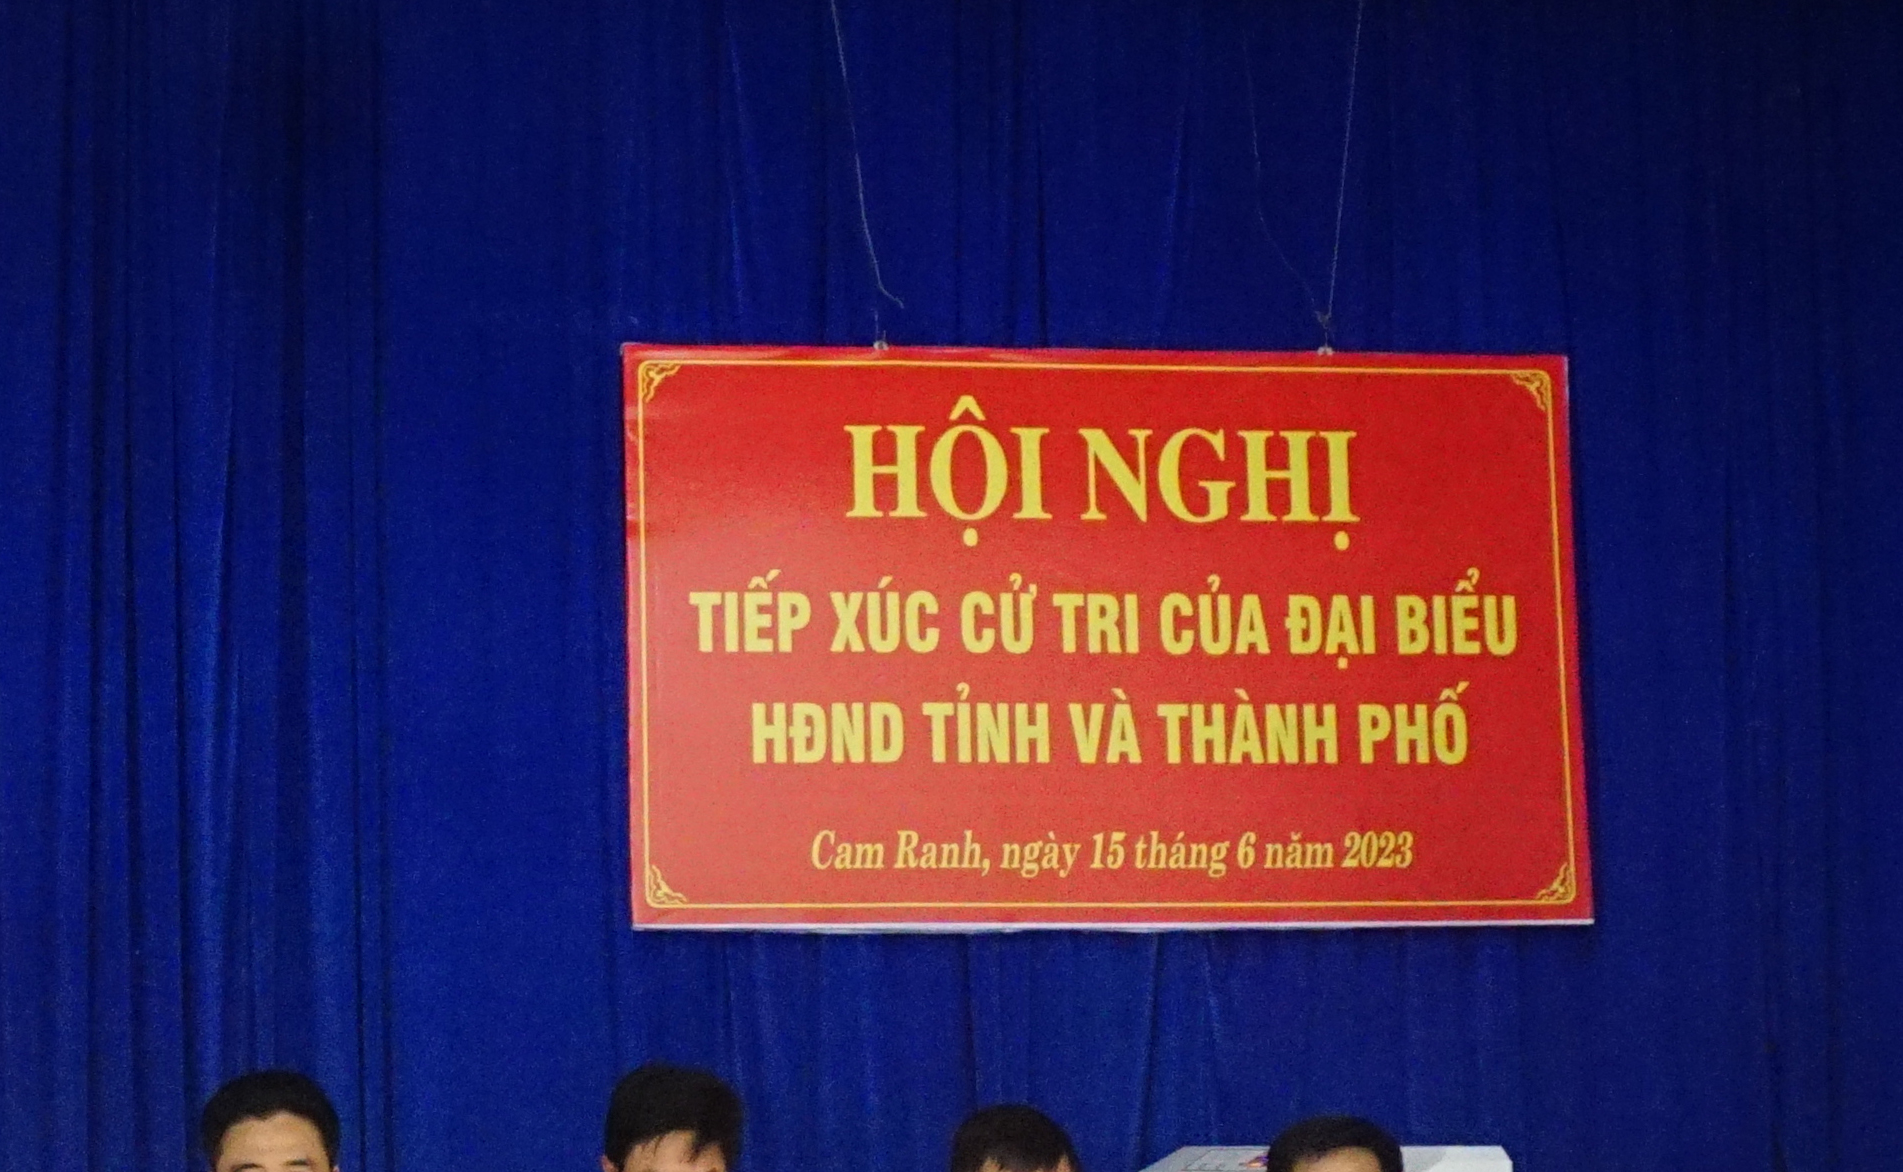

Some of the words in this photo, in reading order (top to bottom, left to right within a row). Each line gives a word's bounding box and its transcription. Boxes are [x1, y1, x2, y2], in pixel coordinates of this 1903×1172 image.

[844, 395, 1053, 547] HỘI
[1079, 426, 1361, 551] NGHỊ
[688, 568, 812, 654] TIẾP
[829, 575, 940, 654] XÚC
[959, 572, 1038, 655] CỬ
[1052, 592, 1140, 654] TRI
[1159, 574, 1270, 656] CỦA
[1285, 594, 1376, 669] ĐẠI
[1396, 567, 1518, 656] BIỂU
[750, 701, 905, 765] HĐND
[922, 681, 1051, 764] TỈNH
[1068, 687, 1142, 764] VÀ
[1156, 688, 1338, 765] THÀNH
[1358, 681, 1469, 765] PHỐ
[810, 829, 885, 870] Cam
[893, 829, 992, 876] Ranh,
[1000, 831, 1082, 879] ngày
[1089, 831, 1126, 870] 15
[1134, 830, 1230, 878] tháng
[1236, 831, 1256, 869] 6
[1264, 833, 1334, 869] năm
[1342, 831, 1414, 869] 2023
